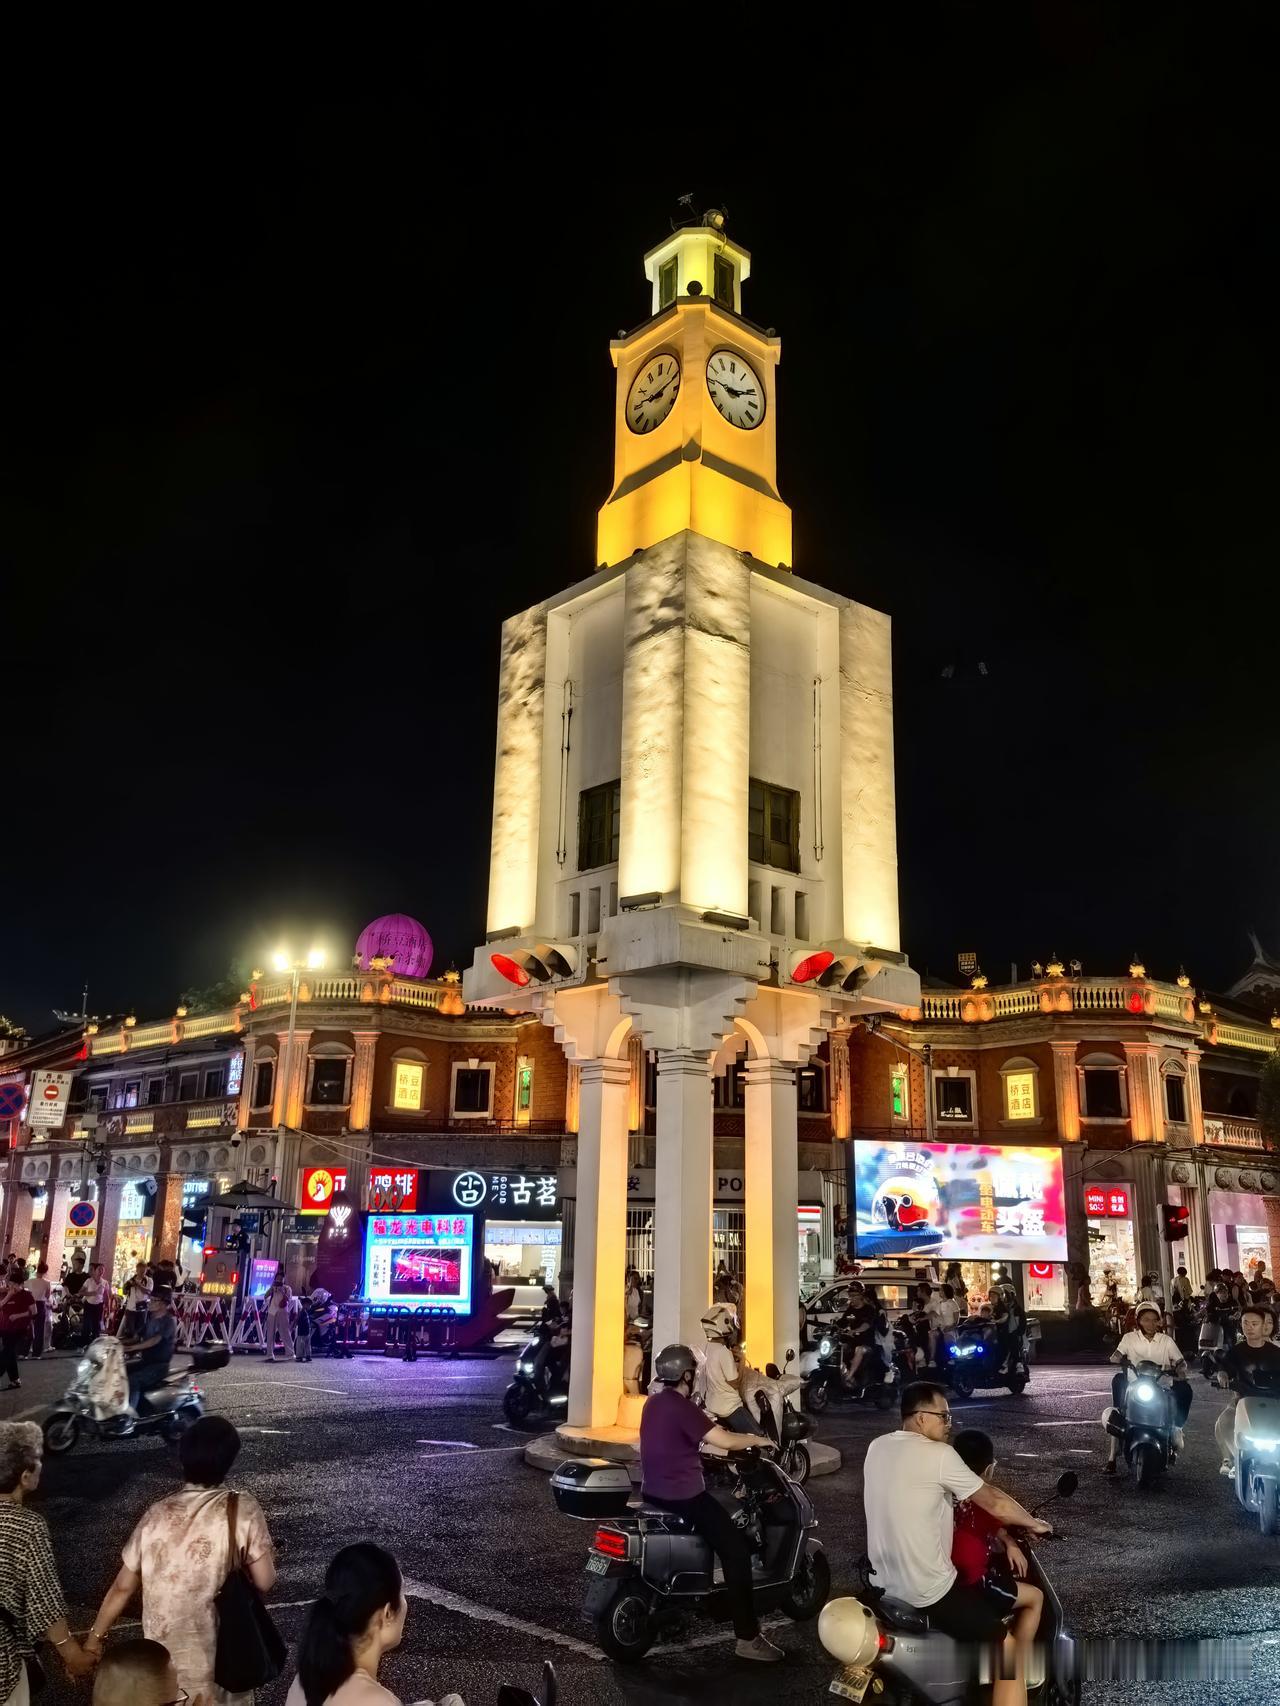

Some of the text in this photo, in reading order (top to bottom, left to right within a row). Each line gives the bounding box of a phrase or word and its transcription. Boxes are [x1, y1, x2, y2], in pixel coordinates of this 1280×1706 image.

[499, 1176, 508, 1204] GOOD
[509, 1175, 558, 1207] 古茗
[1088, 1195, 1104, 1203] MINI
